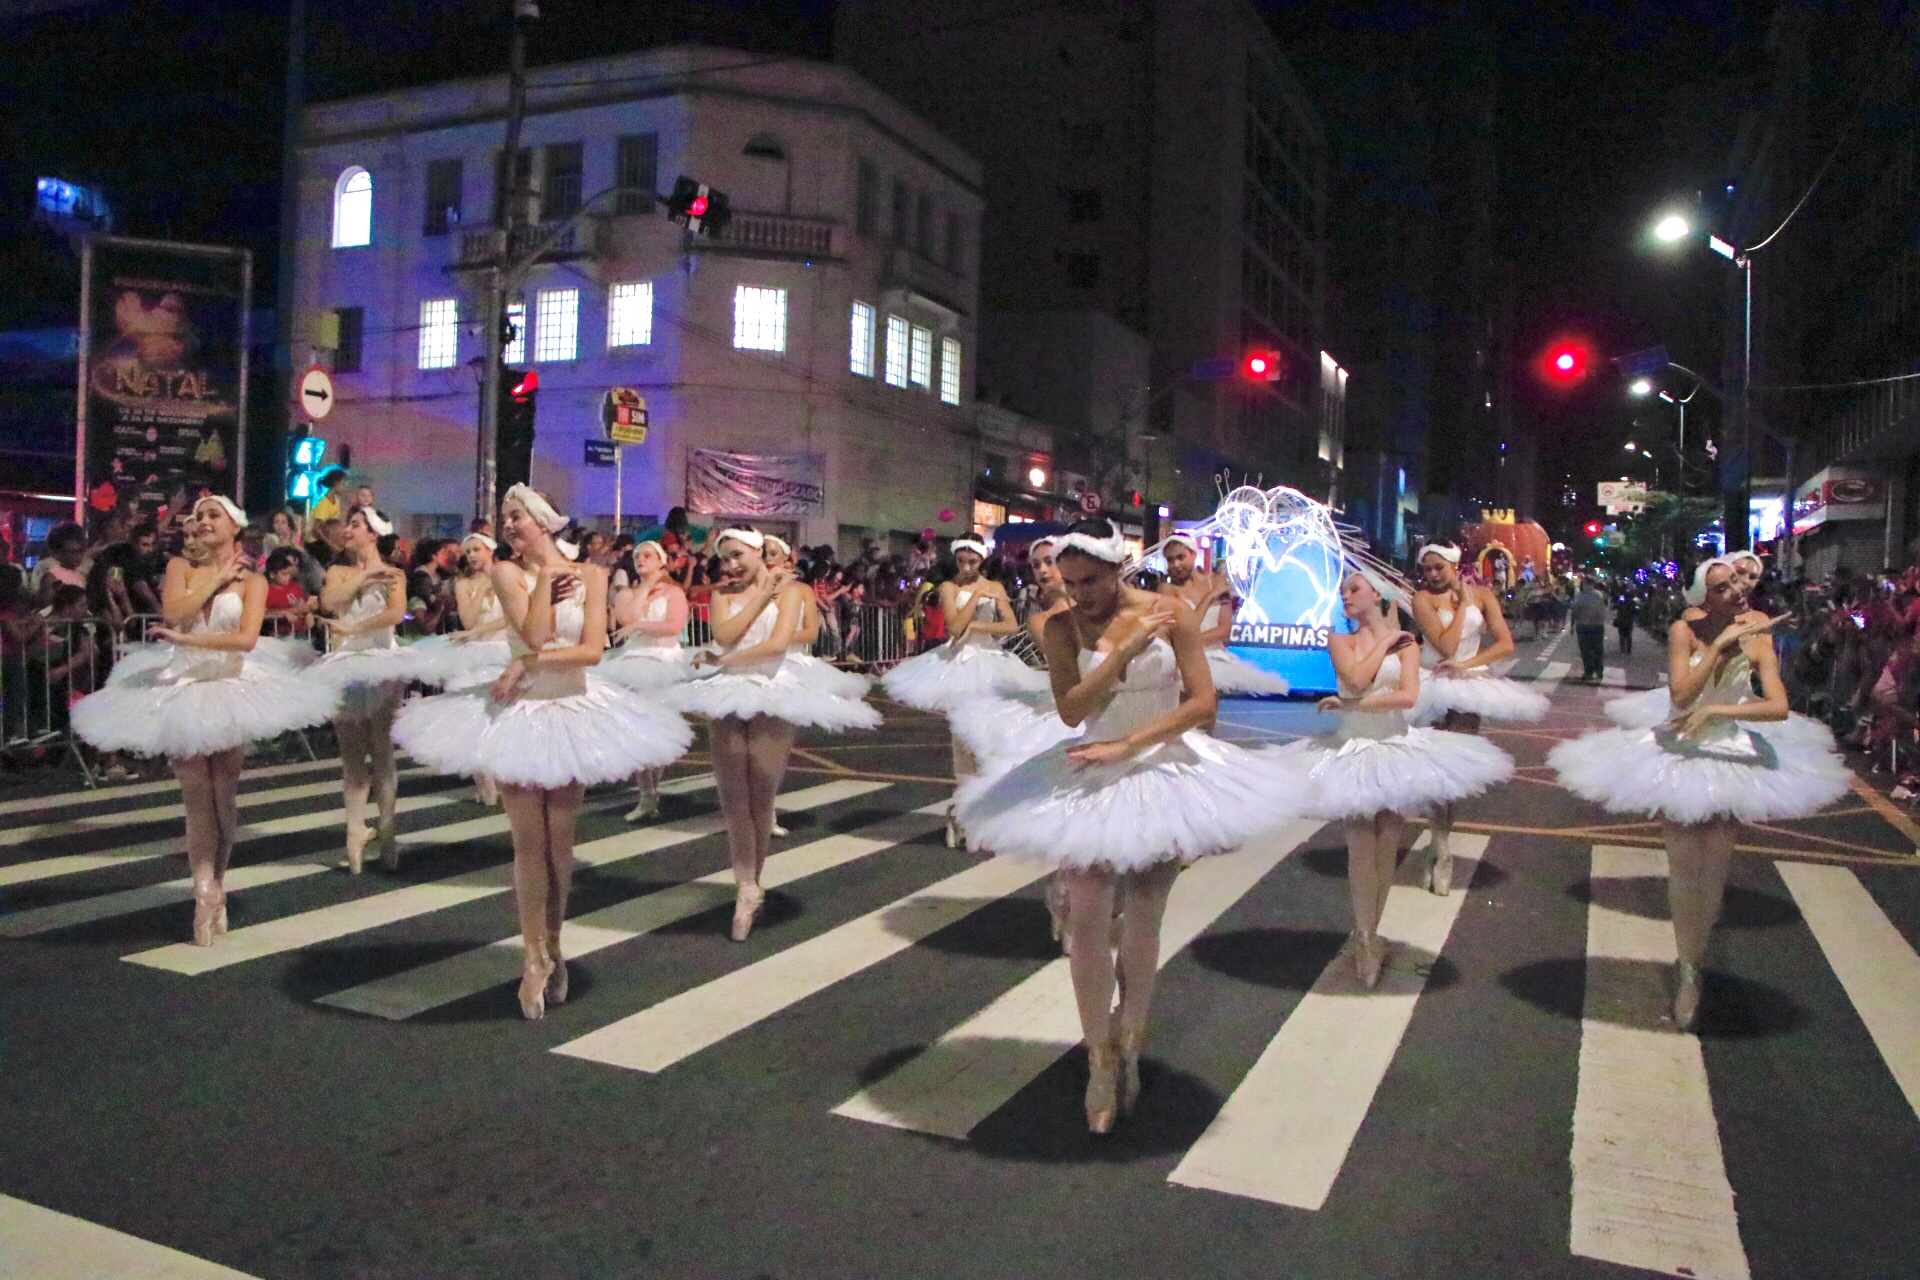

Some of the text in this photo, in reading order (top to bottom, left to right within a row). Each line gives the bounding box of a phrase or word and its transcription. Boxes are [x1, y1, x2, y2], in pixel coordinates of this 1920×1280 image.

[115, 366, 217, 399] NATAL
[631, 410, 645, 424] SIM
[1229, 624, 1329, 647] CAMPINAS
